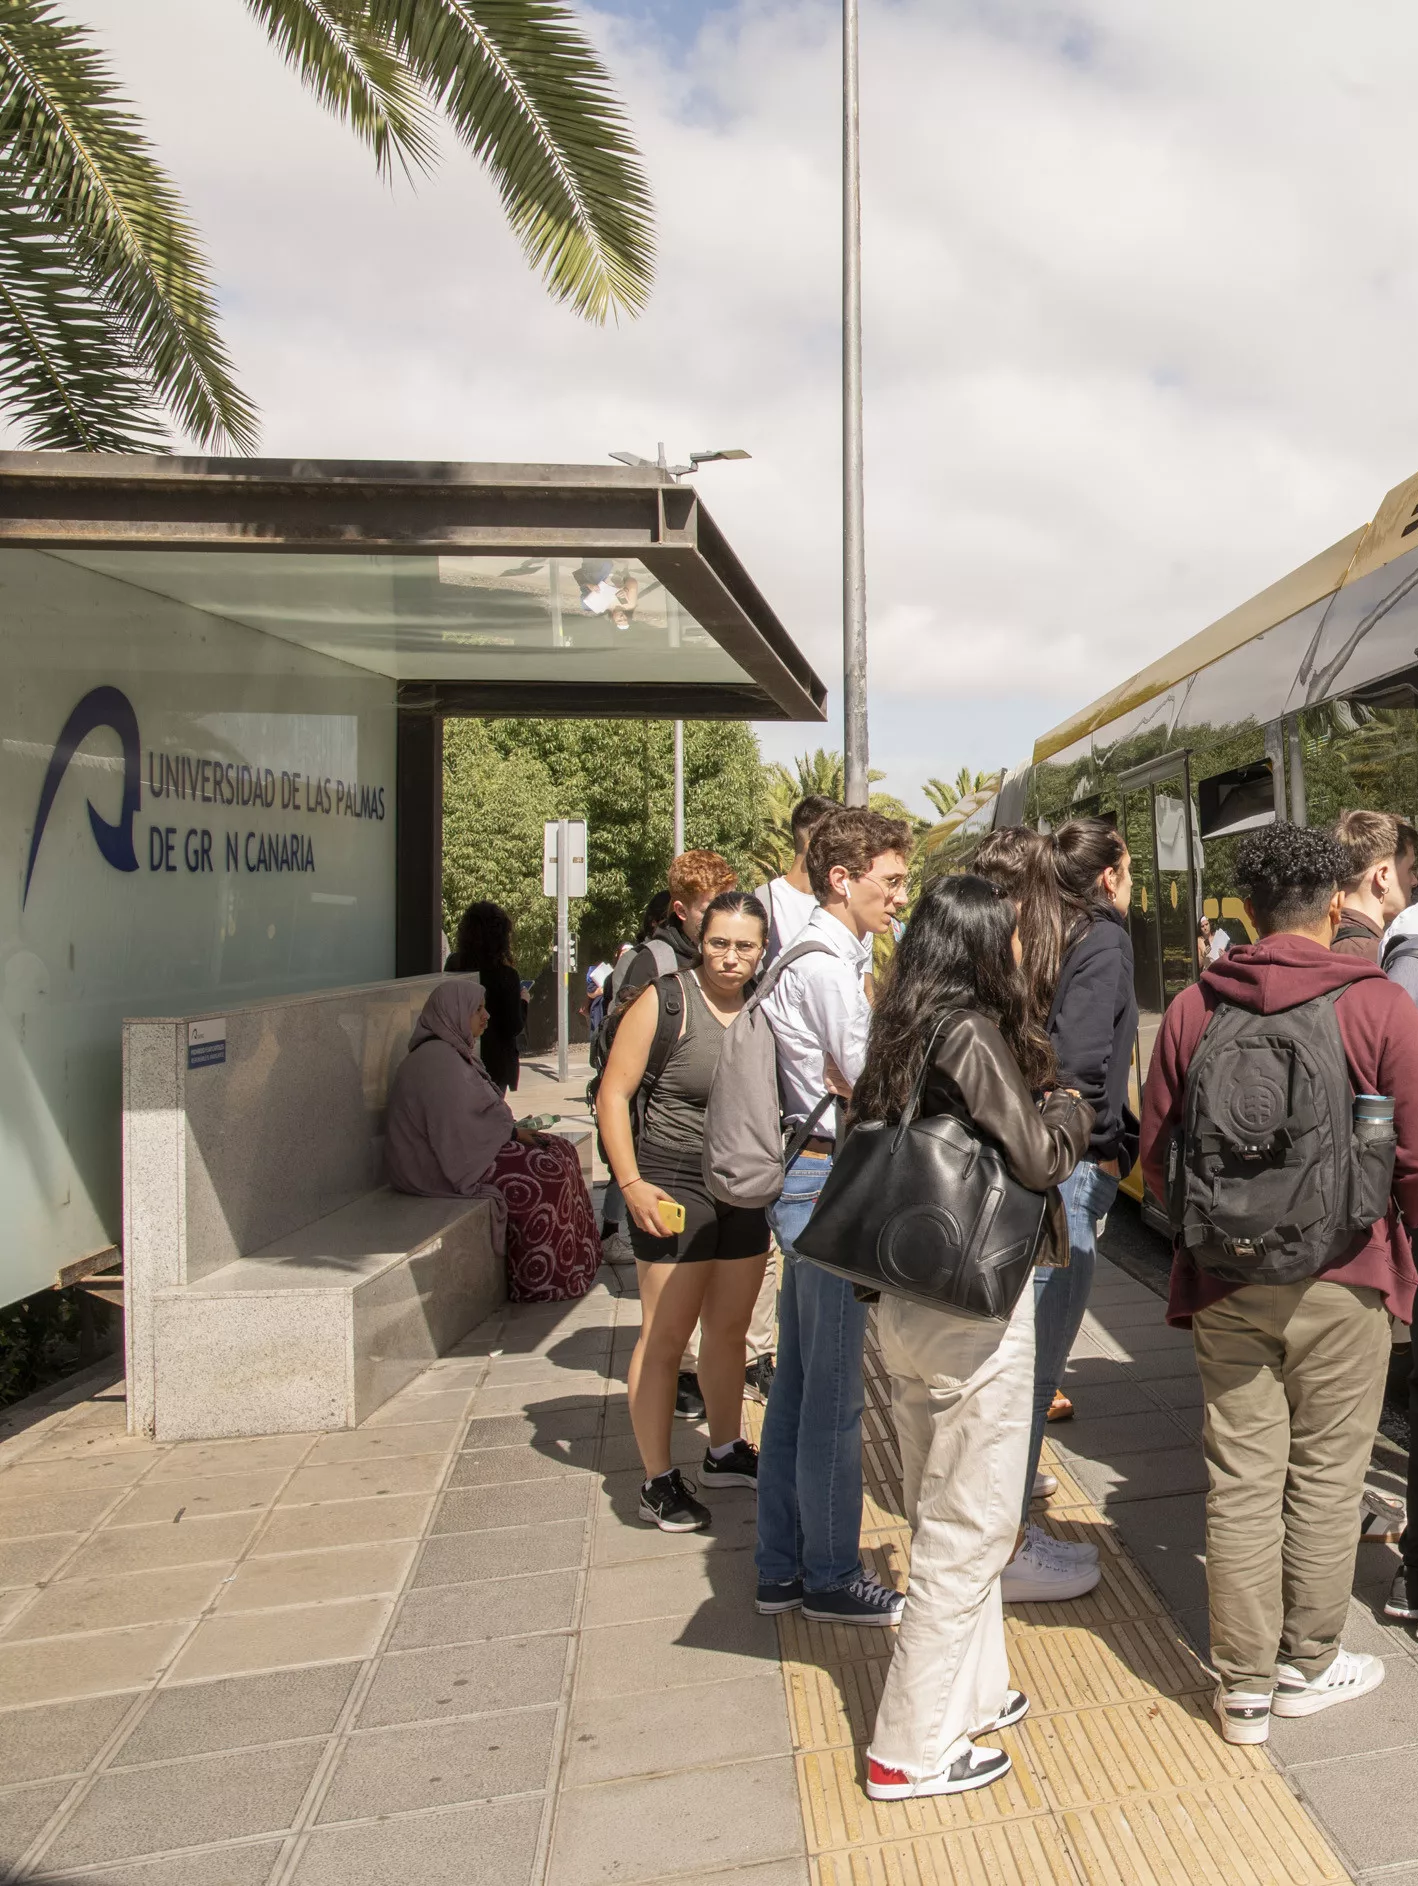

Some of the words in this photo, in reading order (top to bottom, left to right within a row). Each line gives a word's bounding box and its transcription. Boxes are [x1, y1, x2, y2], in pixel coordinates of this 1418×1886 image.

[149, 751, 275, 809] UNIVERSIDAD
[281, 772, 302, 811] DE
[306, 775, 332, 816] LAS
[336, 780, 386, 821] PALMAS
[150, 827, 176, 872] DE
[245, 831, 315, 873] CANARIA
